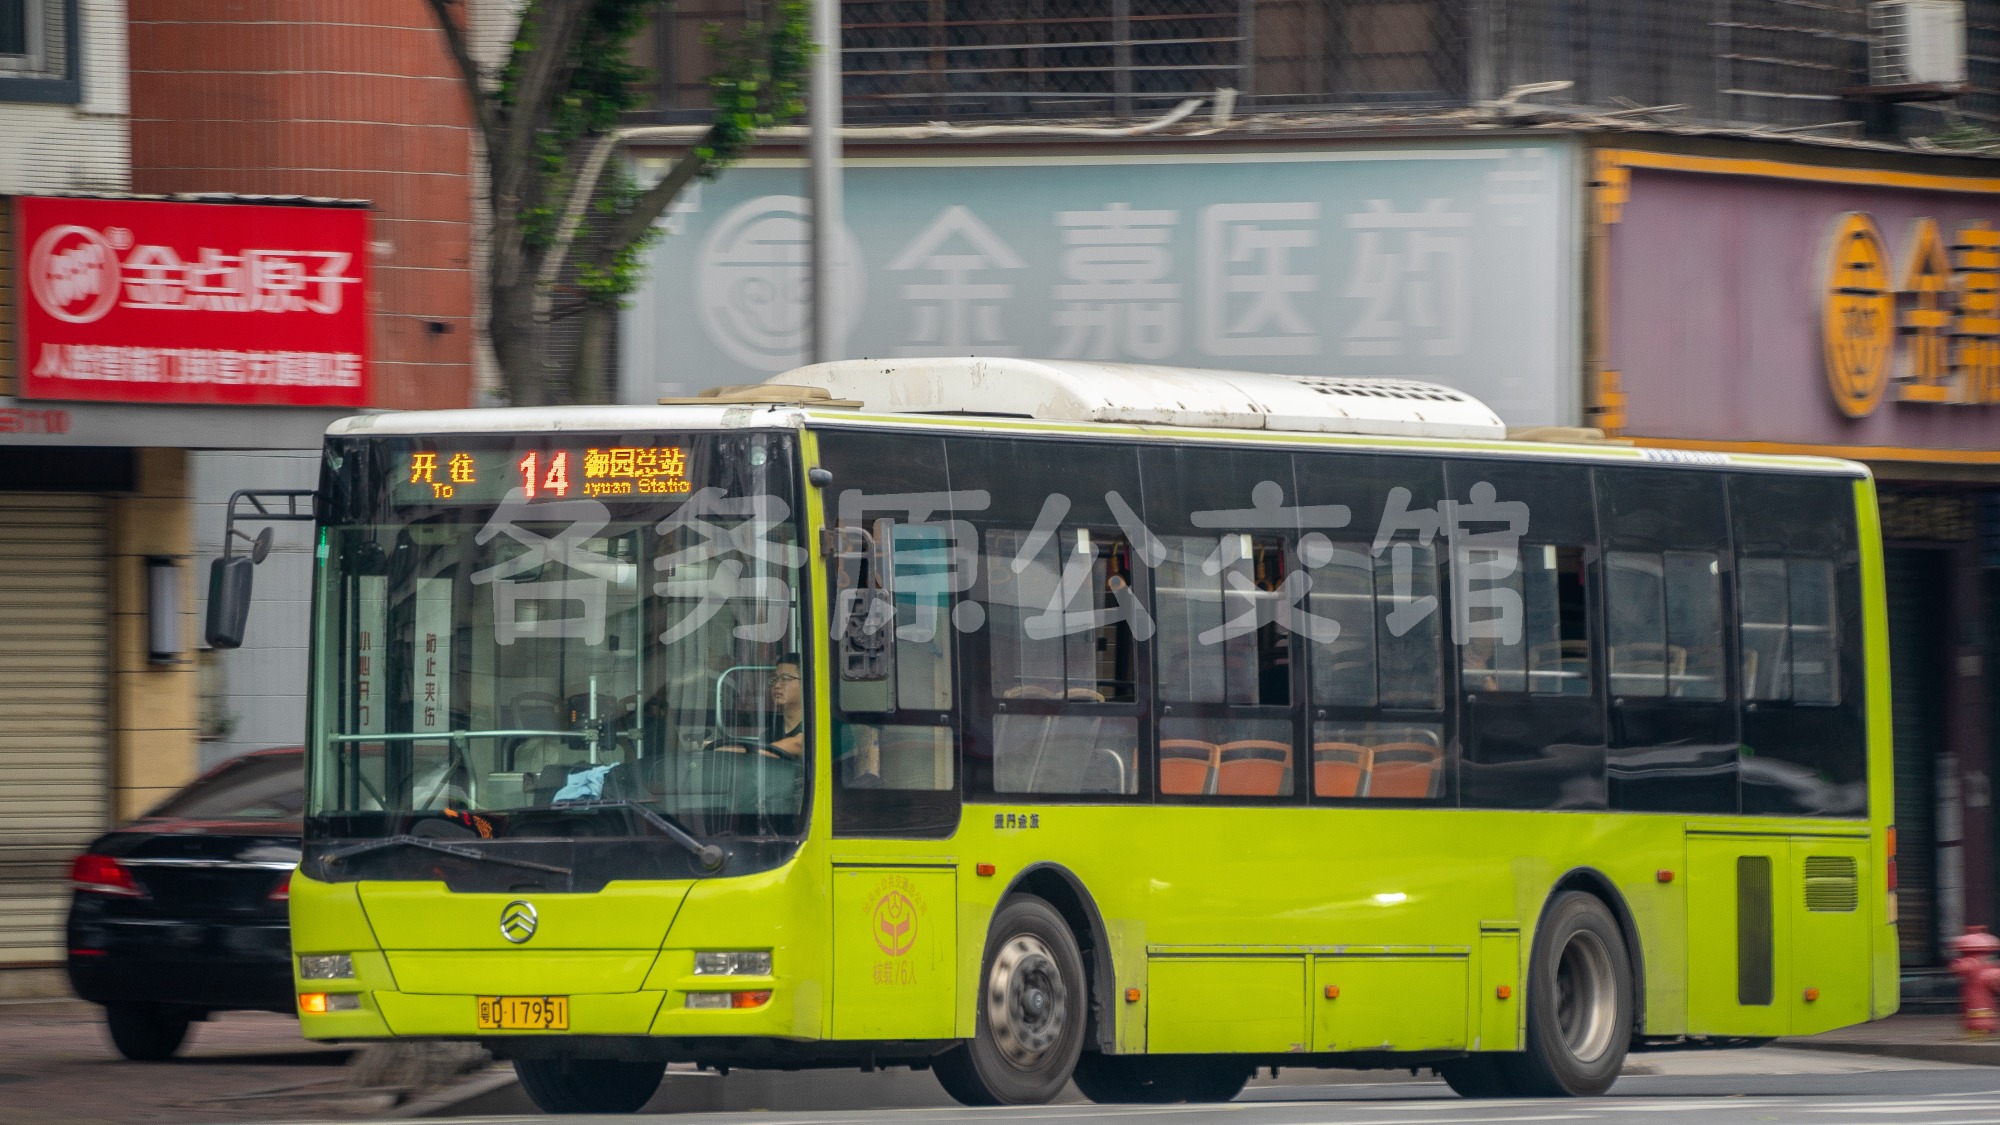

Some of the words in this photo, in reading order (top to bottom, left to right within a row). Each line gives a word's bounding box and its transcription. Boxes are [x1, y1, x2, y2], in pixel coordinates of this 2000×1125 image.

[120, 244, 362, 315] 金点原子
[888, 201, 1474, 359] 金嘉医药
[411, 453, 475, 483] 开往
[432, 483, 453, 498] To
[520, 452, 569, 497] 14
[424, 633, 437, 727] 防止夹伤
